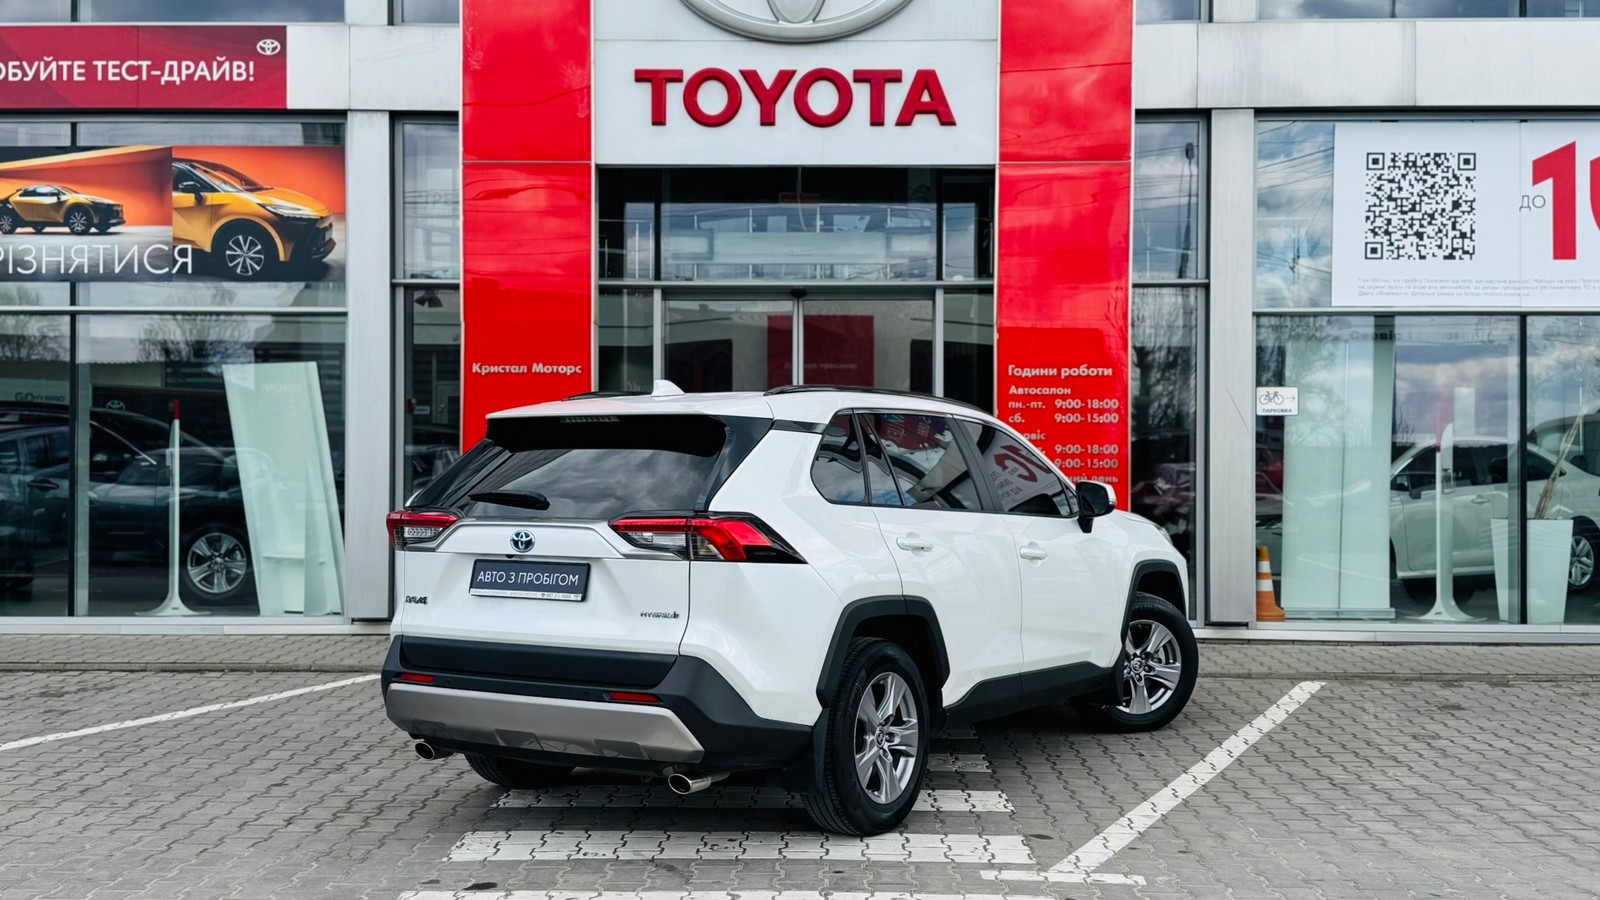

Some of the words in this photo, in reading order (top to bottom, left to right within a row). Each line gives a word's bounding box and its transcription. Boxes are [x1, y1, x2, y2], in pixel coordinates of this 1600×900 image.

[0, 57, 85, 81] БУЙТЕ
[93, 57, 255, 85] ТЕСТ-ДРАЙВ!
[634, 67, 957, 127] TOYOTA
[1532, 141, 1600, 260] 1
[472, 362, 527, 375] Кристал
[532, 362, 582, 375] Моторс
[1008, 365, 1057, 377] Години
[1061, 364, 1112, 378] роботи
[1009, 385, 1071, 395] Автосалон
[1008, 401, 1046, 409] пн.-пт.
[1008, 413, 1025, 423] сб.
[477, 570, 506, 583] АВТО
[518, 572, 579, 586] ПРОБІГОМ
[405, 595, 428, 605] RAV4
